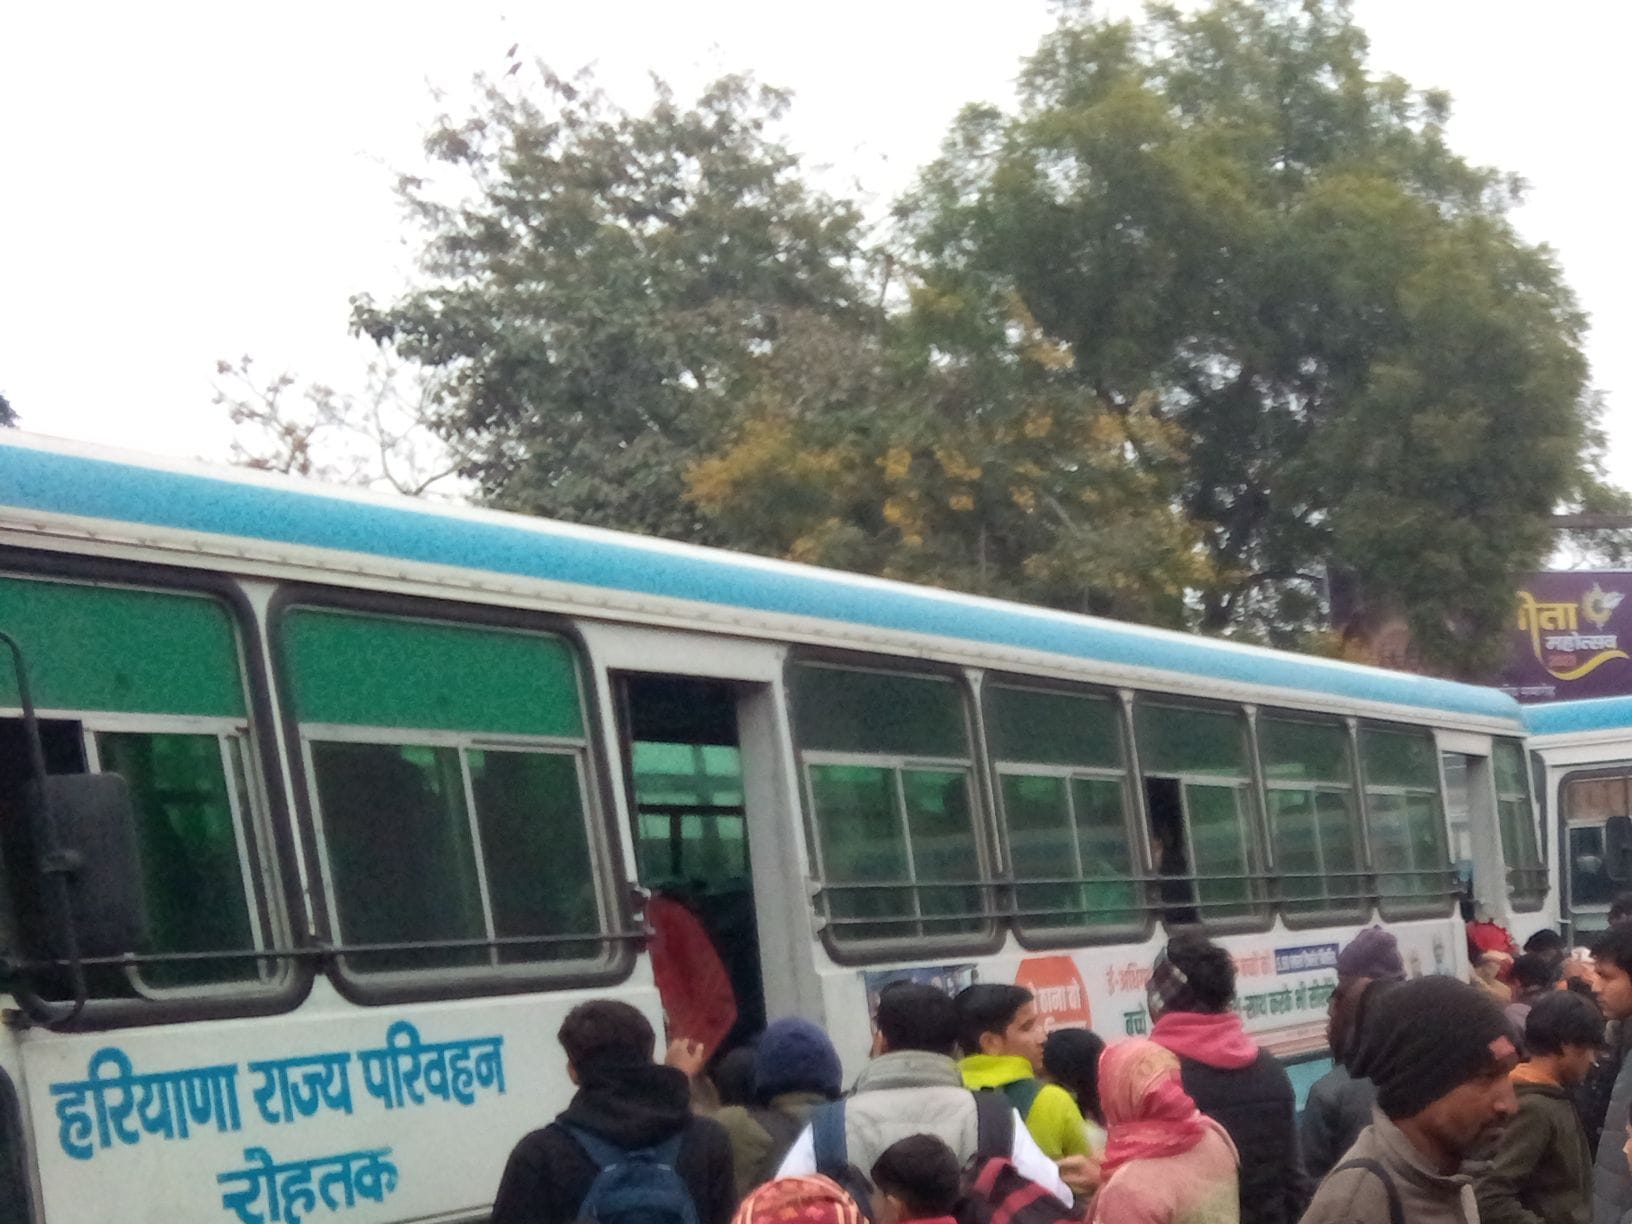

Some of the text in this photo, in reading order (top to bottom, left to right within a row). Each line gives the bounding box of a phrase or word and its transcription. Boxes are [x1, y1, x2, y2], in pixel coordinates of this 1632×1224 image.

[50, 1020, 507, 1160] हरियाणा राज्य परिवहन
